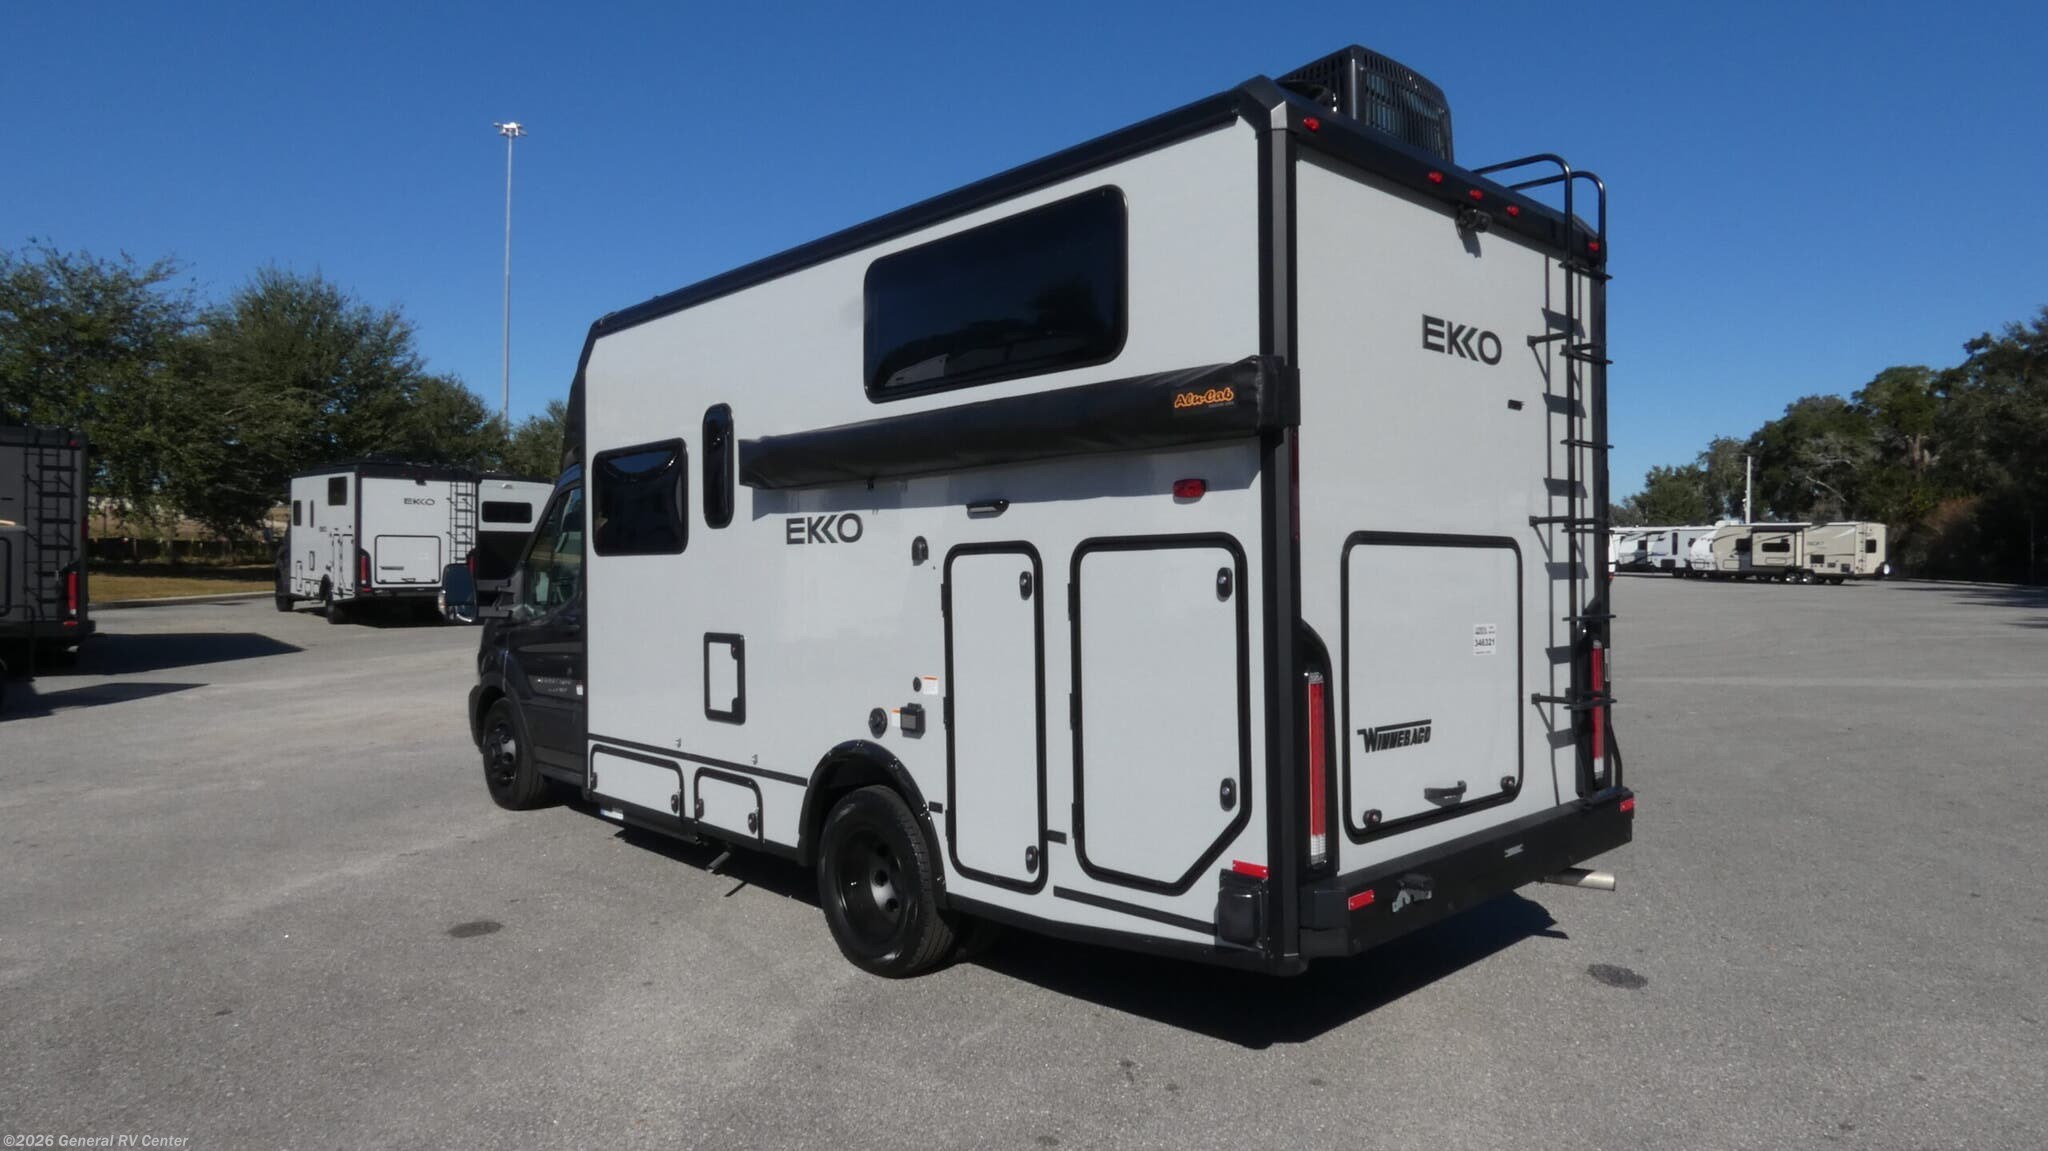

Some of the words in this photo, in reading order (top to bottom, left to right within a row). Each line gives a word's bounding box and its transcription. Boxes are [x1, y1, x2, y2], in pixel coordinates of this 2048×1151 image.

[1422, 313, 1502, 366] EKKO
[403, 497, 436, 506] EKKO
[786, 512, 864, 545] EKKO
